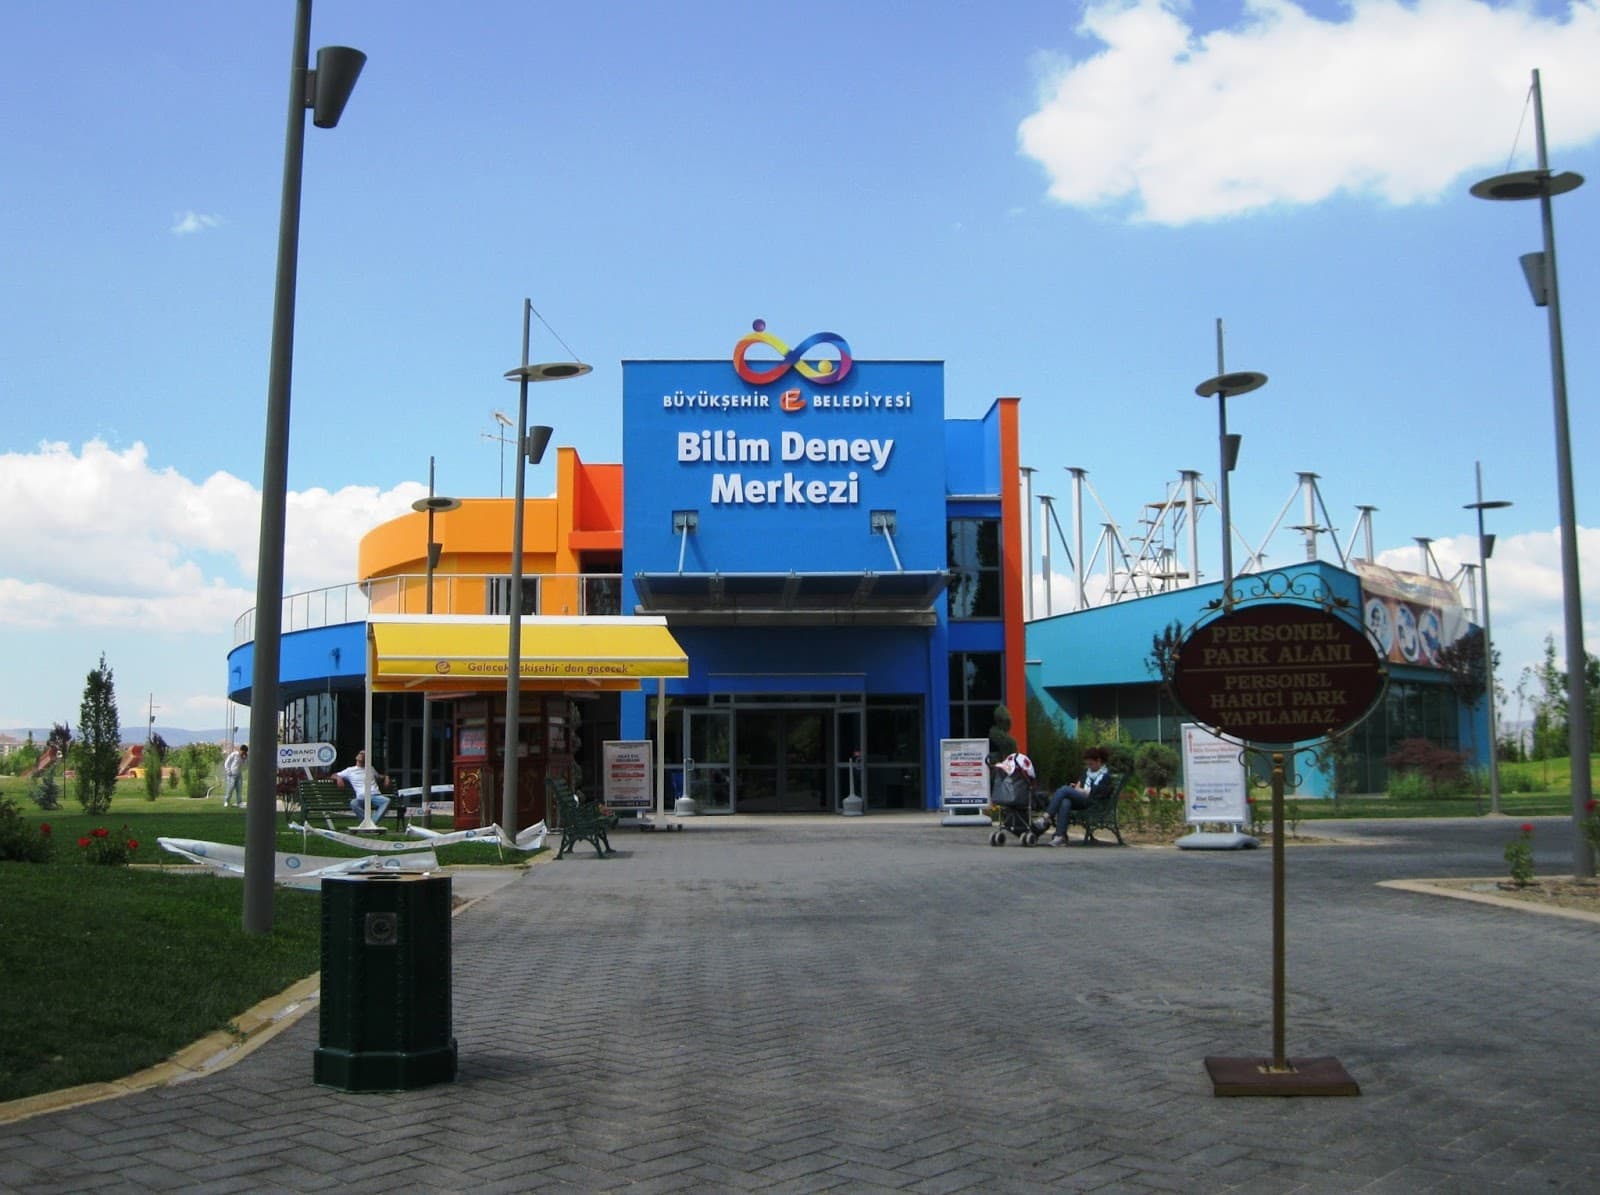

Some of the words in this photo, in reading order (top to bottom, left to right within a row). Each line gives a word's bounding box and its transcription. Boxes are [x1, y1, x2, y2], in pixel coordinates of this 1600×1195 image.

[663, 390, 770, 410] BÜYÜKŞEHİR
[813, 391, 912, 408] BELEDİYESİ
[678, 430, 770, 462] Bilim
[781, 431, 894, 471] Deney
[711, 472, 859, 504] Merkezi
[1211, 623, 1340, 643] PERSONEL
[1202, 646, 1270, 666] PARK
[1277, 644, 1352, 663] ALANI
[1224, 672, 1332, 690] PERSONEL
[1211, 690, 1284, 709] HARİCİ
[1292, 689, 1346, 706] PARK
